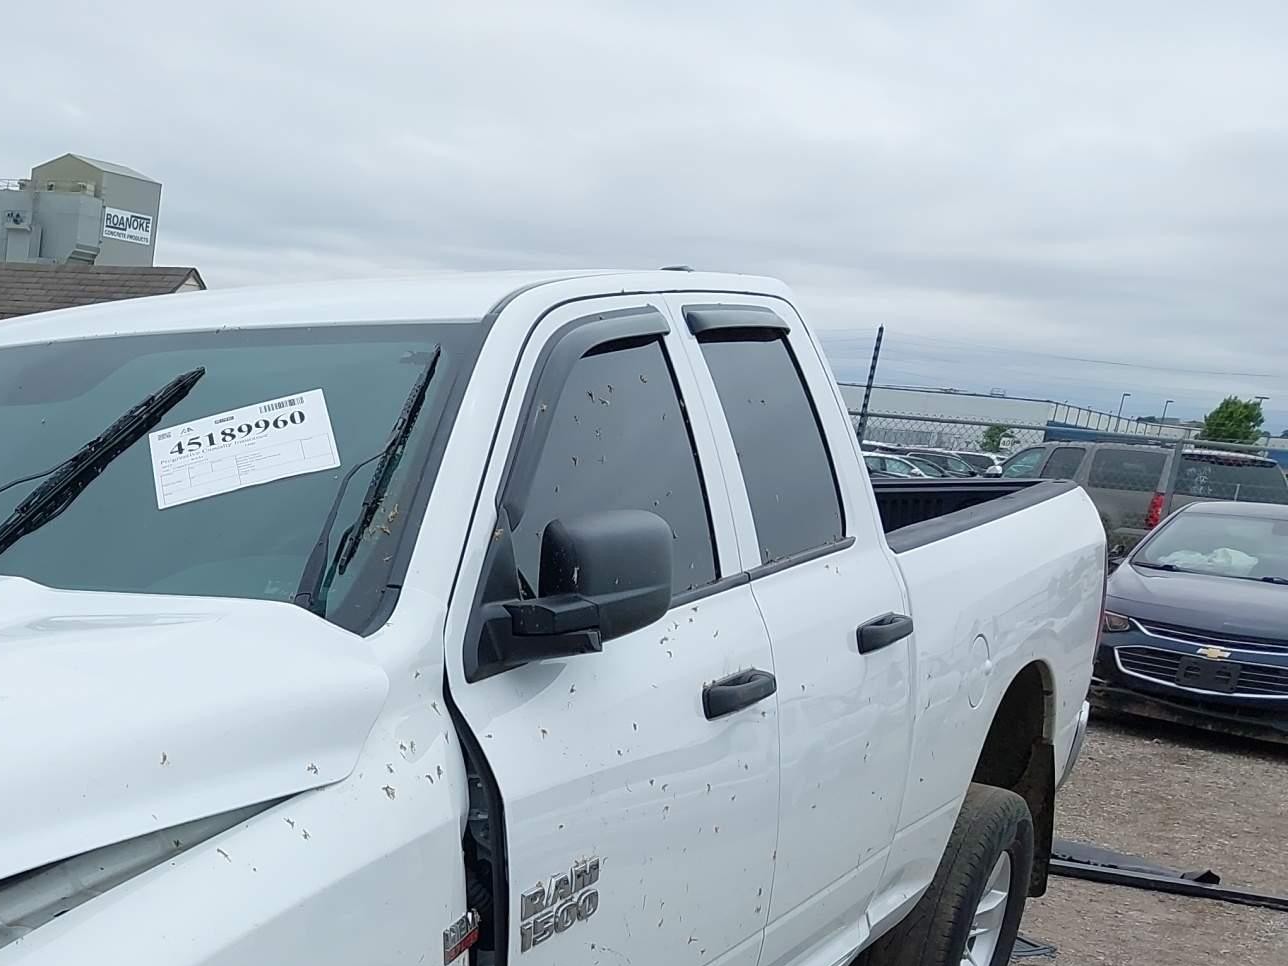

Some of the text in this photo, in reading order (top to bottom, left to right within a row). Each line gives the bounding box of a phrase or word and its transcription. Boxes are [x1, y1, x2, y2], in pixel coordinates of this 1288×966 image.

[105, 213, 150, 232] ROANOKE
[170, 410, 306, 455] 45189960
[520, 857, 600, 921] RAM
[520, 888, 599, 954] 1500
